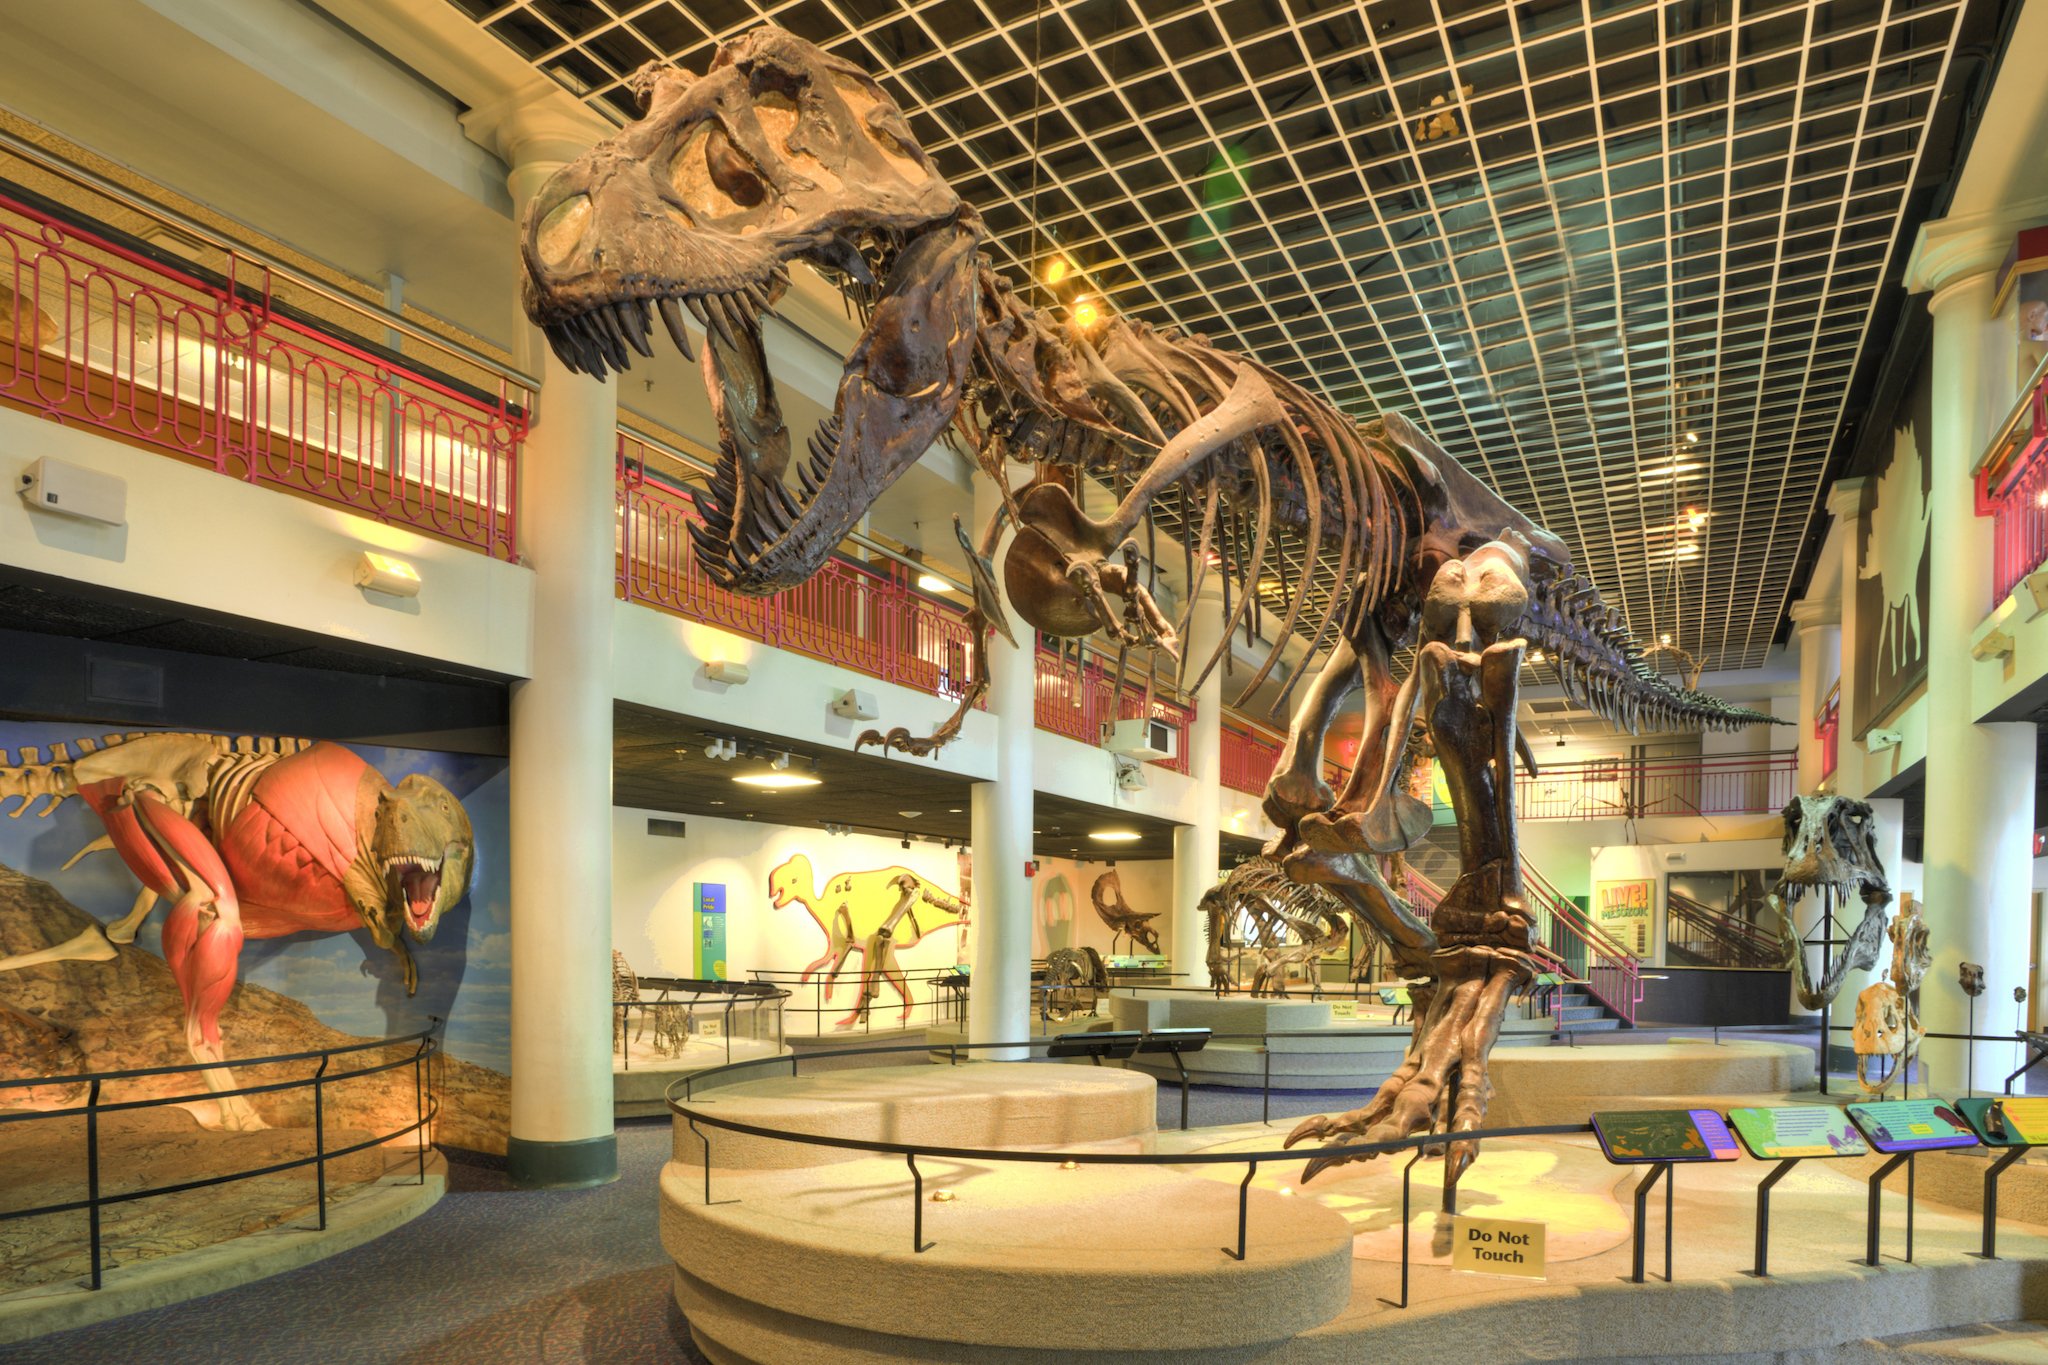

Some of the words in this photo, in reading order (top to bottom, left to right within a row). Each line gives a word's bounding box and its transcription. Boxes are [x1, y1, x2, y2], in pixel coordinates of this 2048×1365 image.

[1602, 882, 1648, 909] LIVE!
[1468, 1228, 1492, 1242] Do
[1498, 1230, 1530, 1246] Not
[1472, 1247, 1524, 1264] Touch
